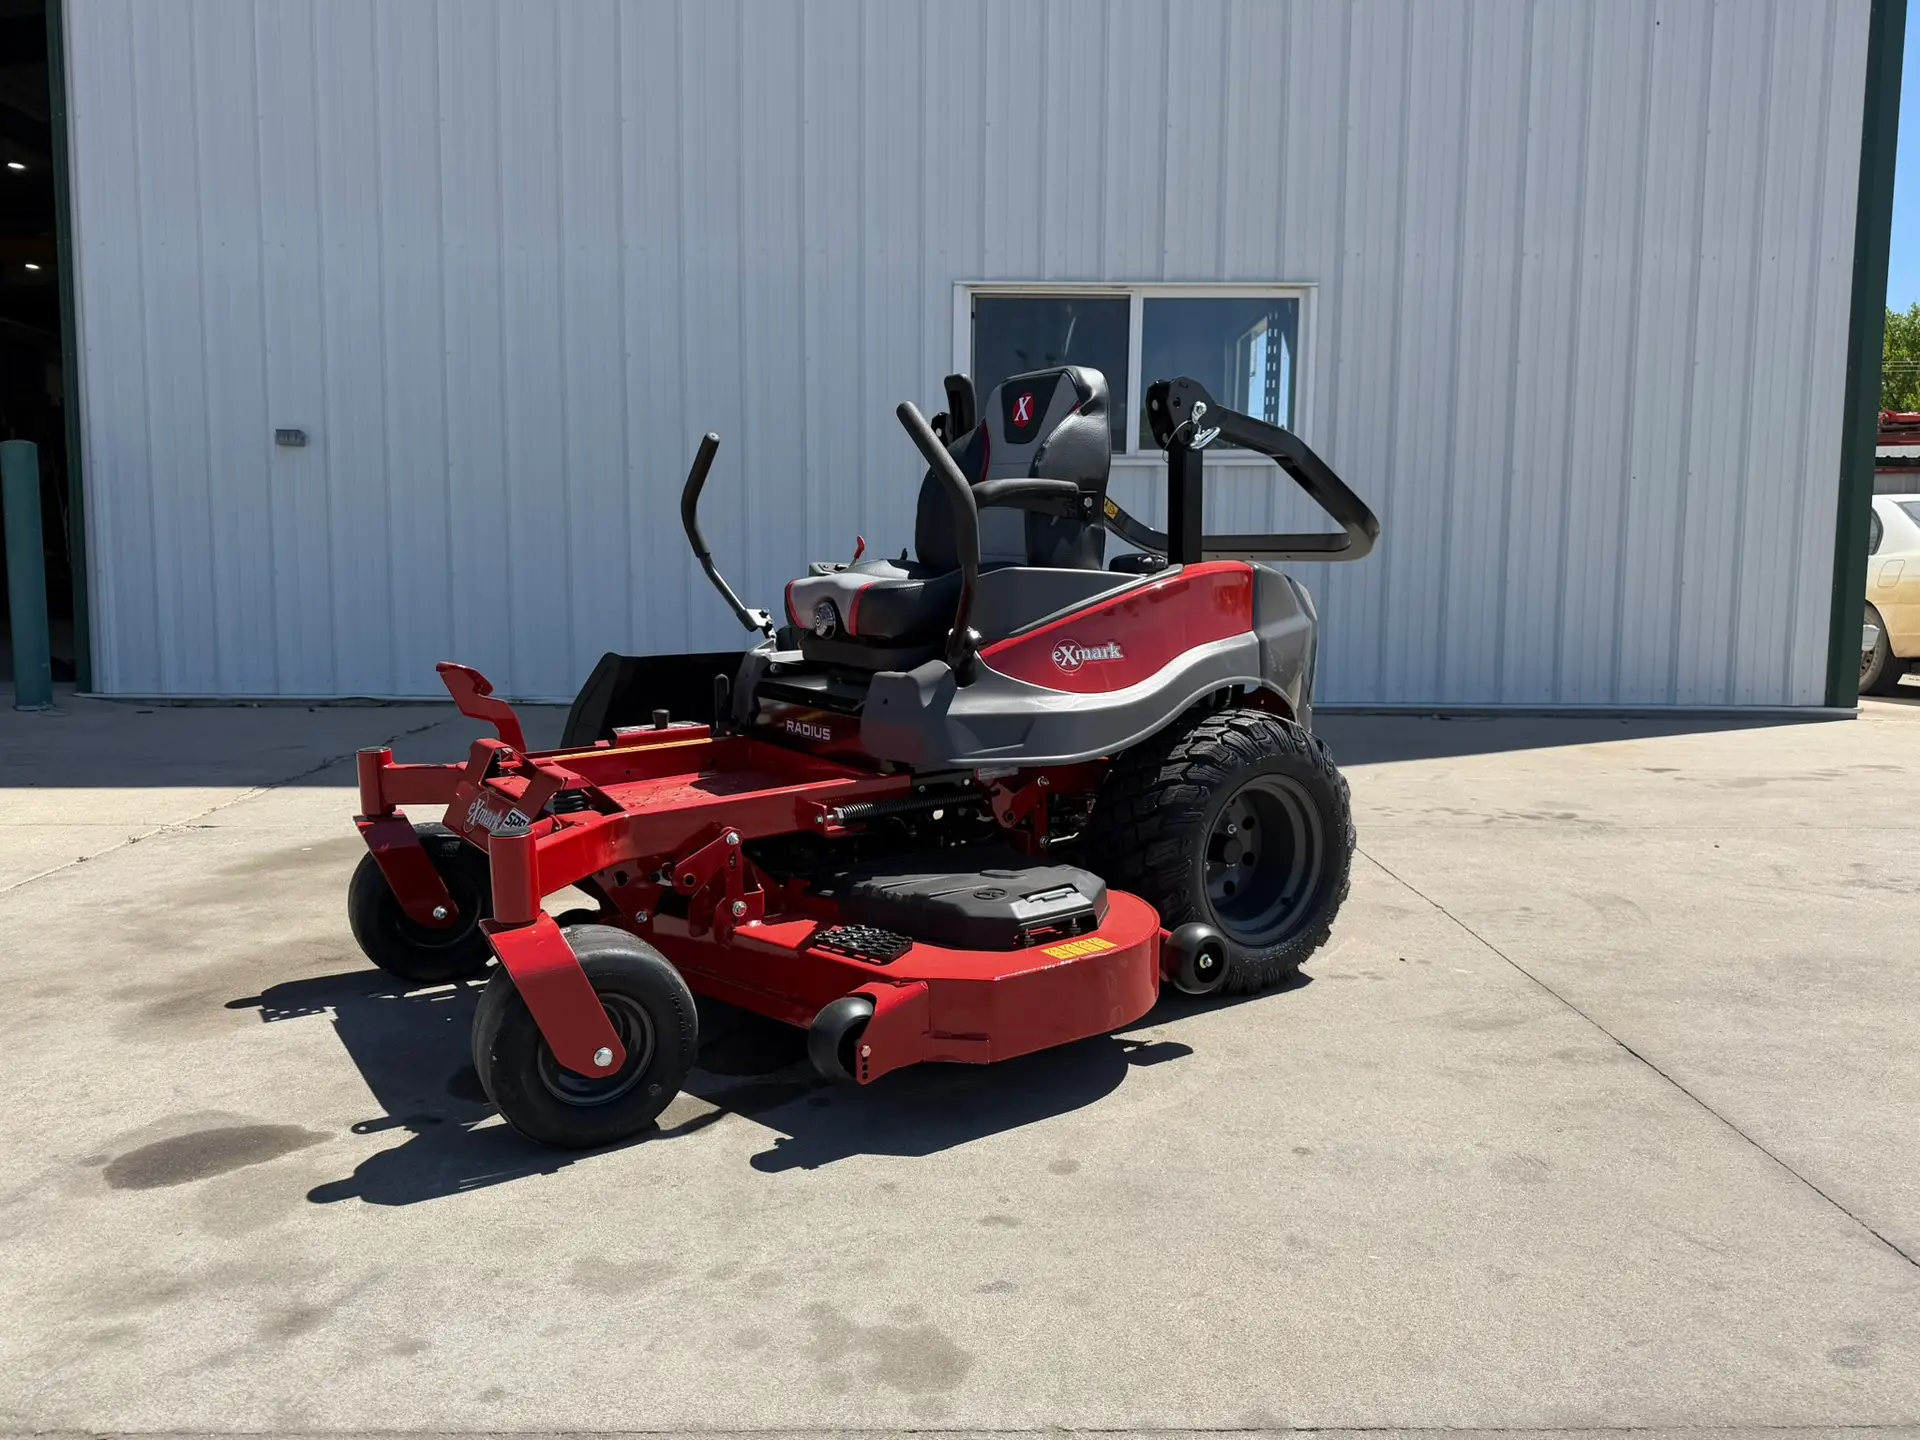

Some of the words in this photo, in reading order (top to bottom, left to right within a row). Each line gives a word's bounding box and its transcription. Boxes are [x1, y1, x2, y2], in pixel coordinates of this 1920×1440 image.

[1014, 395, 1032, 421] X
[1052, 641, 1123, 667] eXmark
[786, 719, 831, 741] RADIUS
